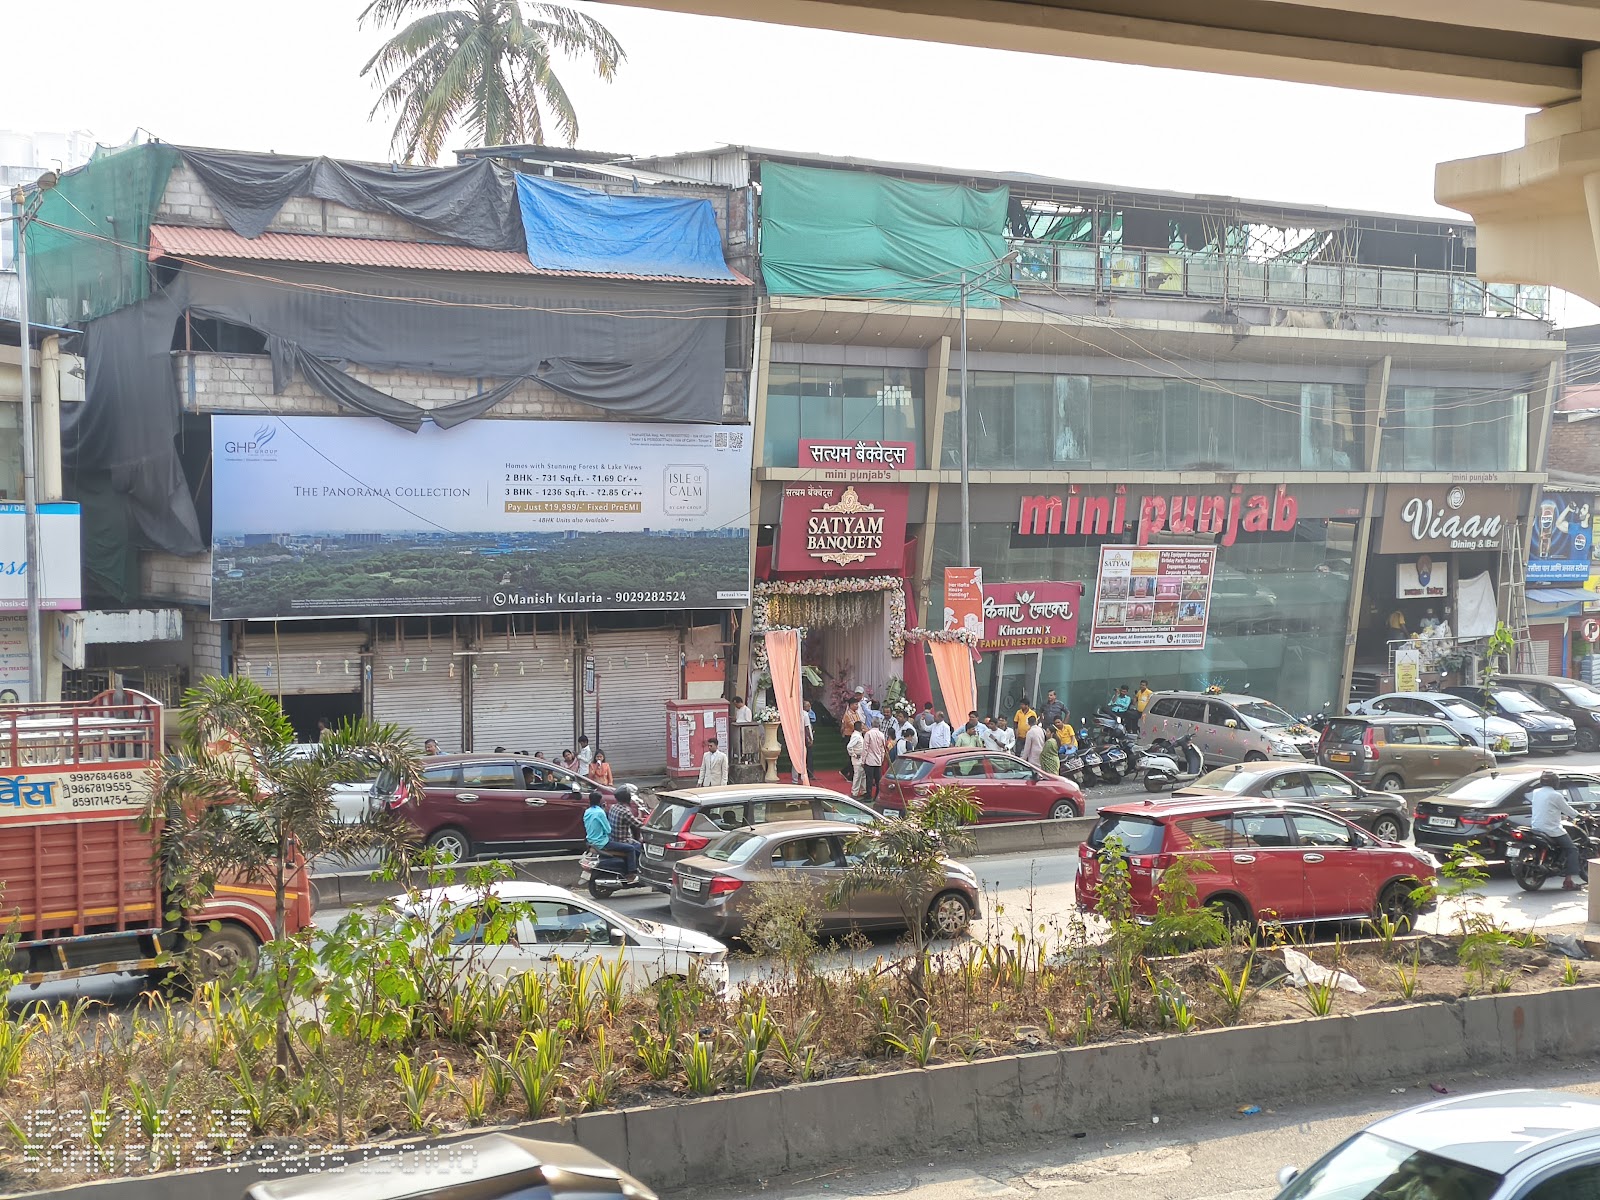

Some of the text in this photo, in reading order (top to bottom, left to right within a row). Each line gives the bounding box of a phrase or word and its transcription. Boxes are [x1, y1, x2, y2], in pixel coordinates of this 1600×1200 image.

[225, 442, 256, 453] GHP
[809, 445, 852, 463] सत्यम
[670, 473, 691, 483] ISLE
[825, 470, 891, 482] mini punjab's
[670, 486, 702, 496] CALM
[508, 504, 521, 513] Pay
[1018, 483, 1298, 547] mini punjab
[1402, 498, 1503, 540] Viaan
[808, 517, 884, 534] SATYAM
[807, 536, 882, 550] BANQUETS
[1451, 539, 1499, 550] Dining & Bar
[508, 593, 552, 605] Manish
[558, 592, 602, 604] Kularia
[615, 592, 686, 603] 9029282524
[999, 625, 1034, 636] Kinara
[980, 638, 1010, 648] FAMILY
[1012, 638, 1042, 646] RESTRO
[1051, 636, 1068, 644] BAR
[70, 772, 133, 782] 9987684688
[71, 782, 132, 794] 9867819555
[73, 795, 128, 807] 8591714754
